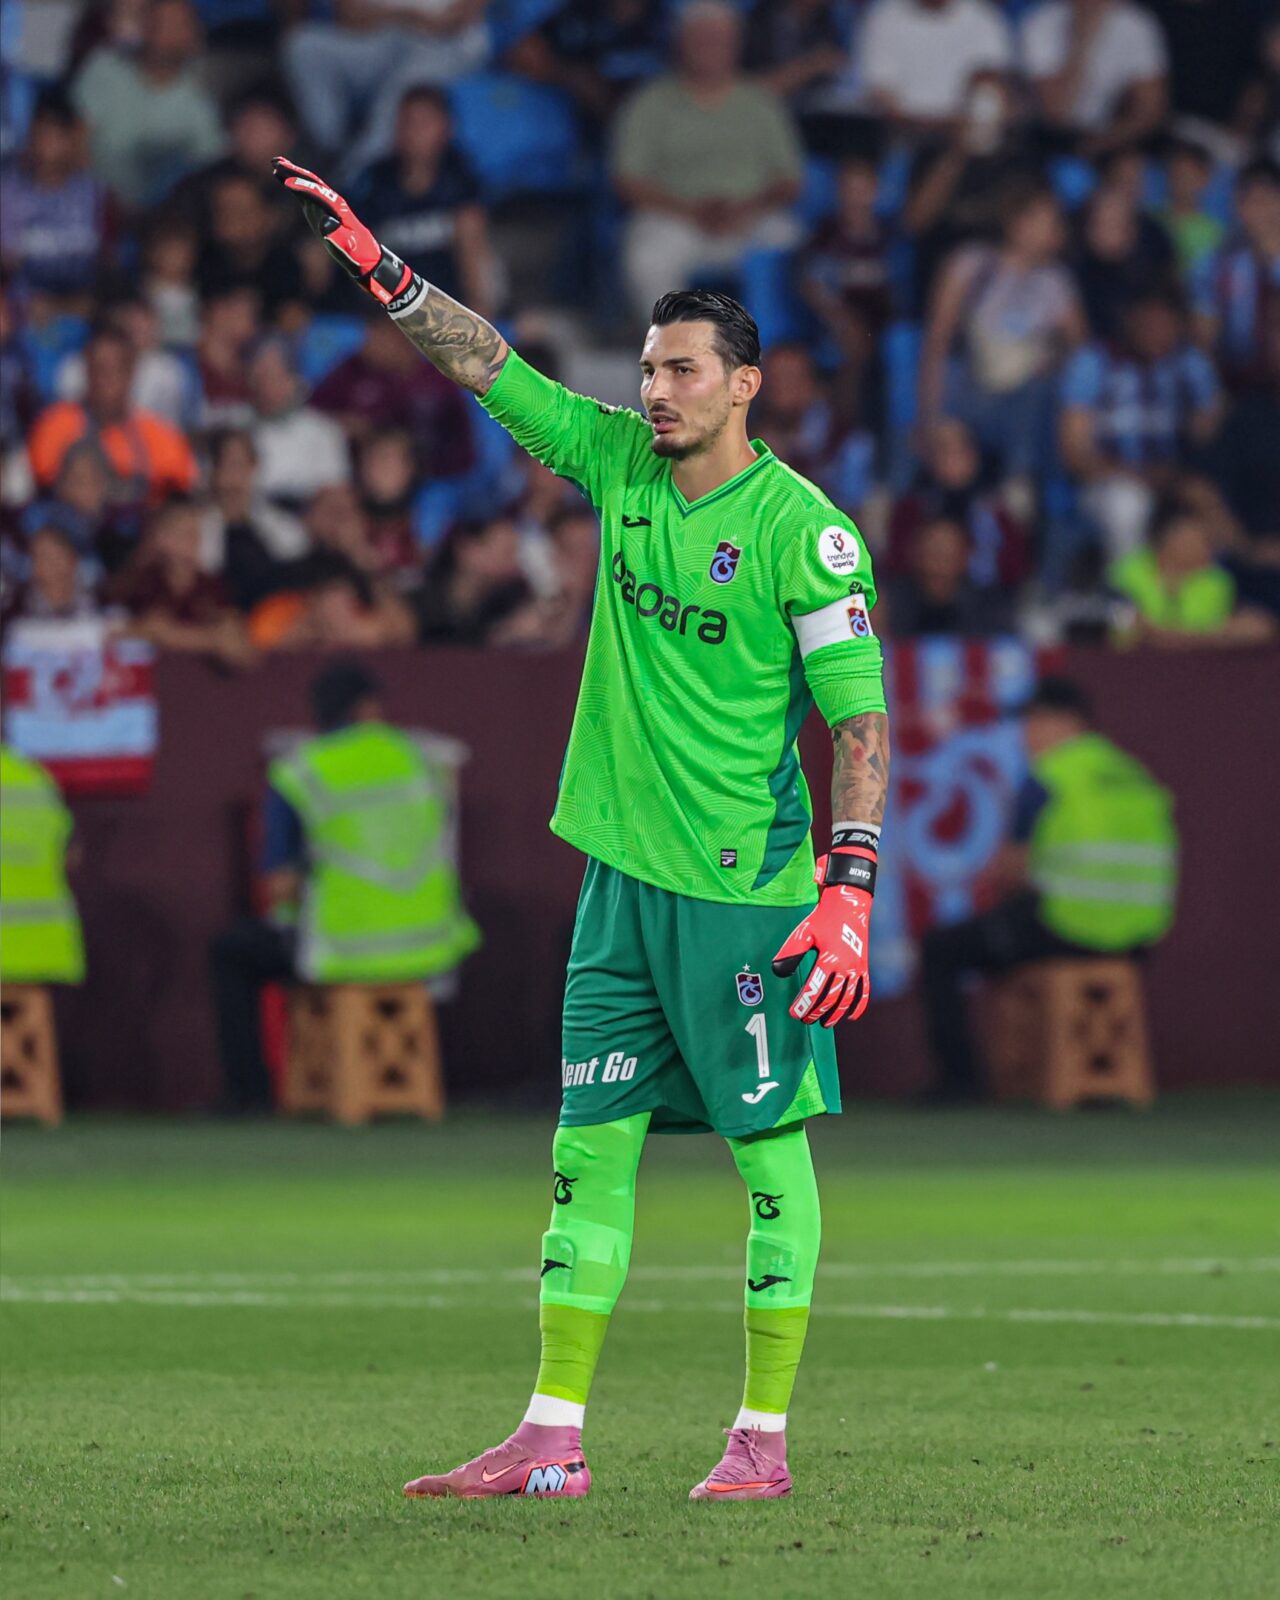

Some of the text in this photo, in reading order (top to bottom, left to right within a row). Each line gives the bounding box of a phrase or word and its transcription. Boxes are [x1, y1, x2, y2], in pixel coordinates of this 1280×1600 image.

[827, 550, 855, 562] trendyol
[793, 966, 827, 1018] ONE
[744, 1012, 771, 1079] 1
[601, 1051, 639, 1083] Go
